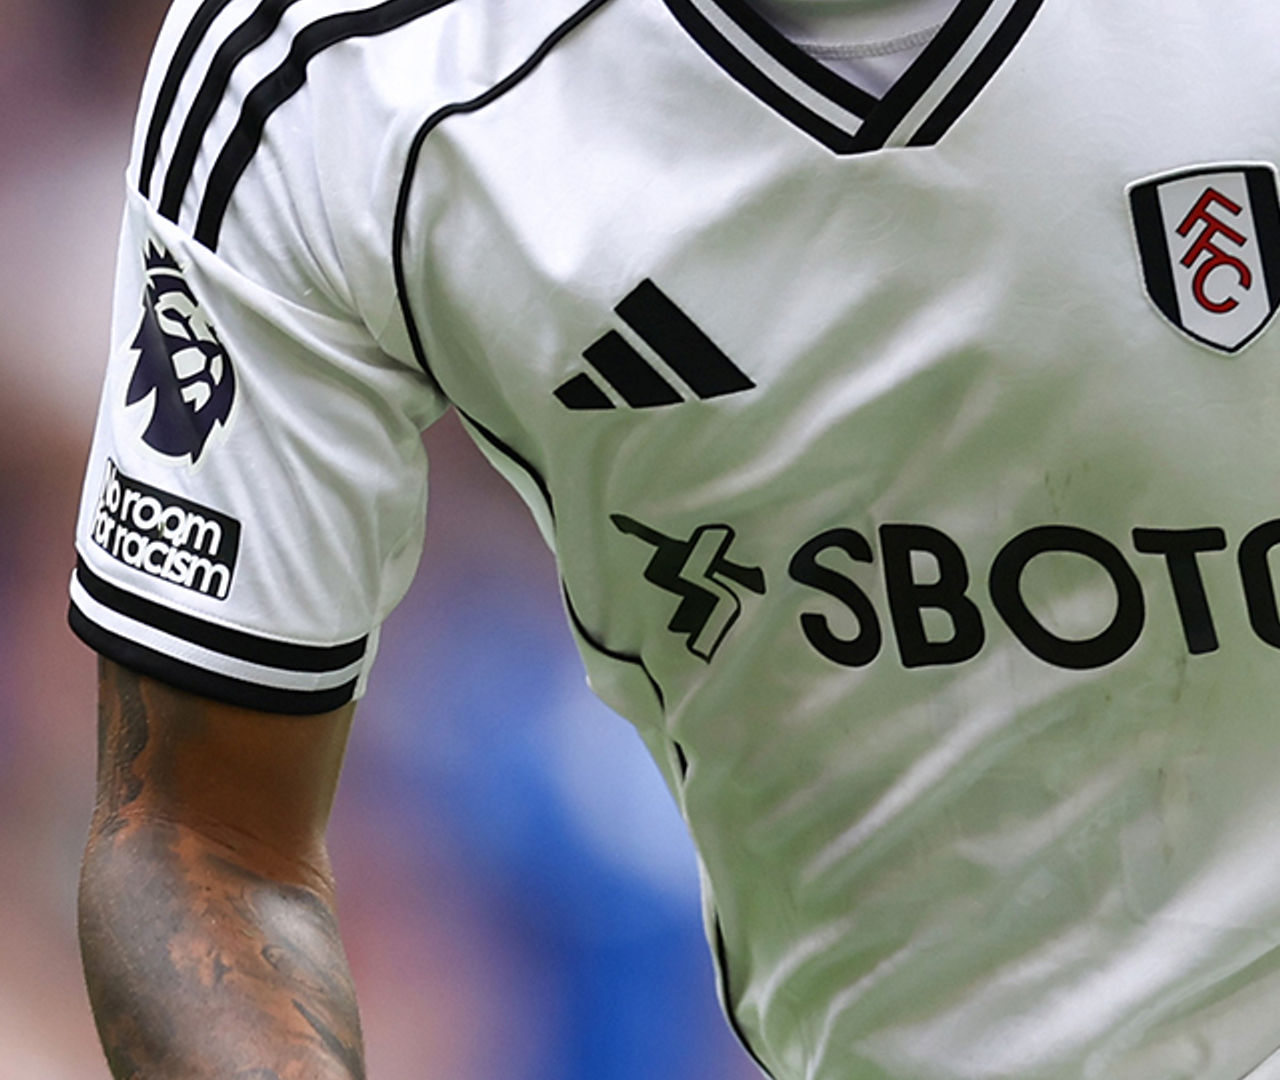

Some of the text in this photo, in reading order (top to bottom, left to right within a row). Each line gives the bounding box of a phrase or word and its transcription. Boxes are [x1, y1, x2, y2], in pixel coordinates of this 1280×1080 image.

[1176, 187, 1252, 314] FFC
[120, 487, 222, 556] room
[112, 524, 230, 599] racism
